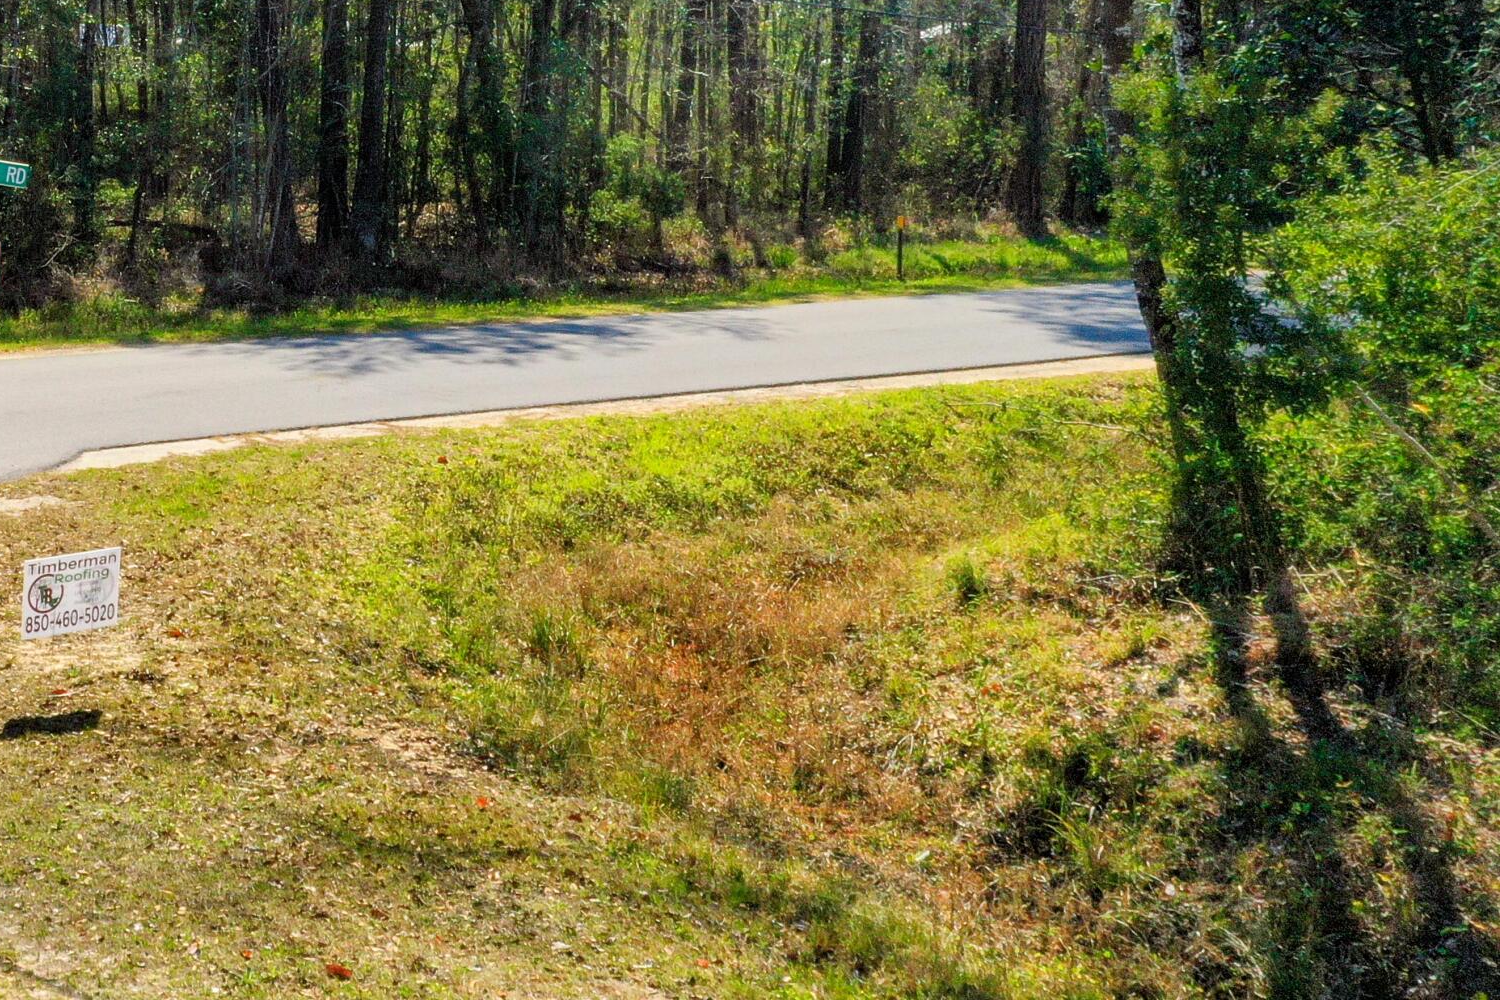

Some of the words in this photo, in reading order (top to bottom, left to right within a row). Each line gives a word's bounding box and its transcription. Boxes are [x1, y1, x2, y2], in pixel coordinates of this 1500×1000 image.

[5, 167, 27, 185] RD
[28, 553, 117, 575] Timberman
[54, 567, 110, 584] Roofing
[25, 603, 115, 634] 850-460-5020
